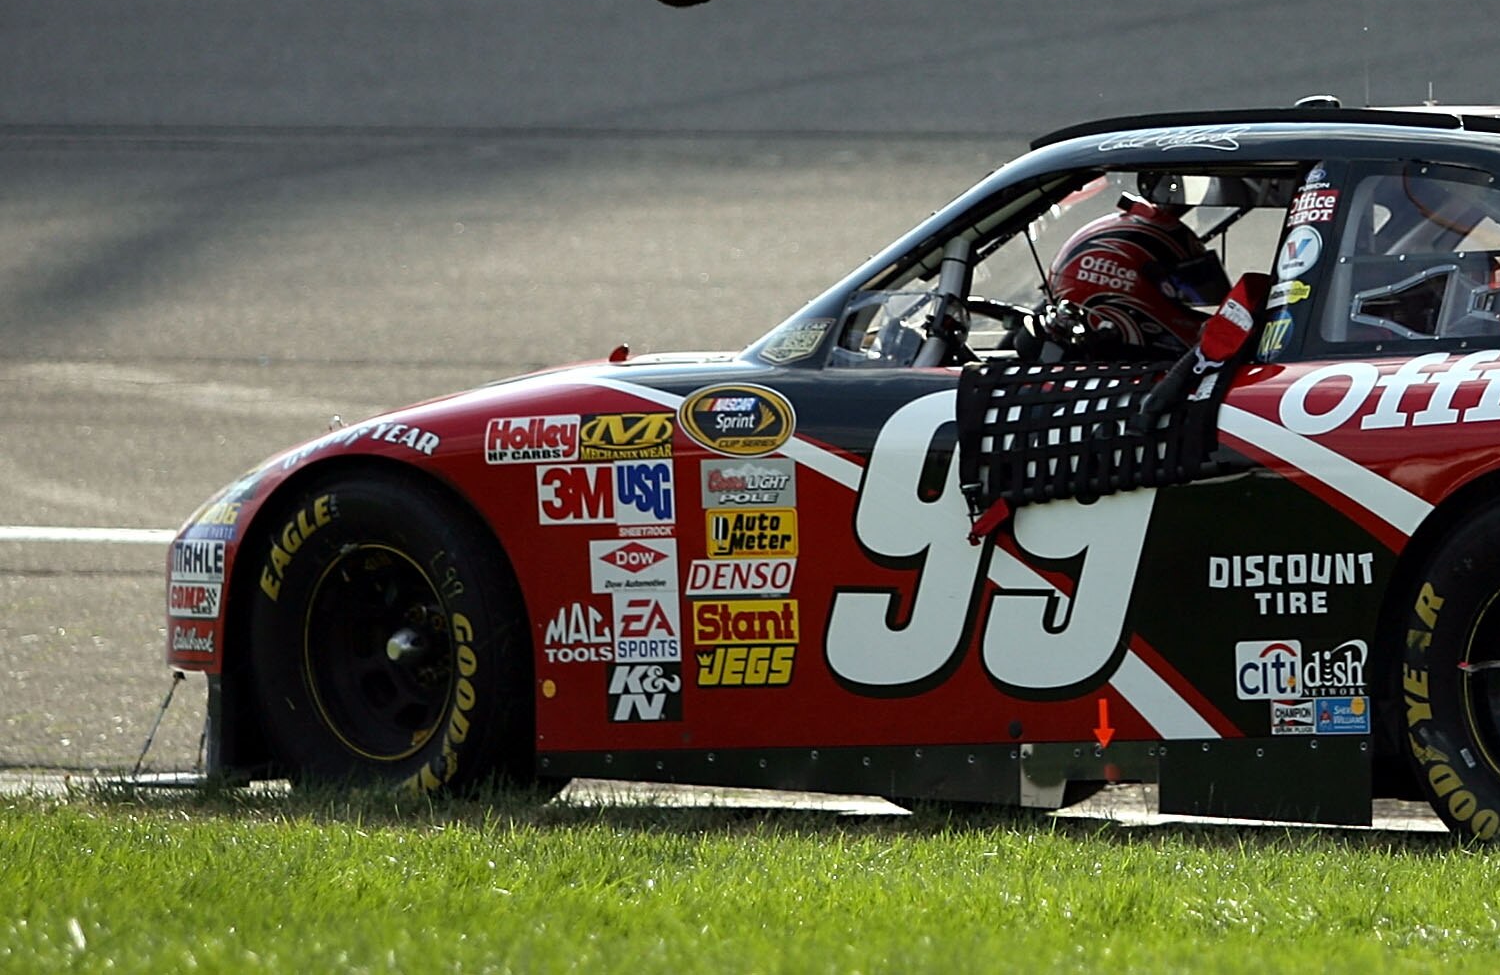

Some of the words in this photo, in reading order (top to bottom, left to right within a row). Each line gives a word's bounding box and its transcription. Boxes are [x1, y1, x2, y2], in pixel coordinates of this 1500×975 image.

[1290, 194, 1337, 214] Office
[1287, 210, 1332, 226] DEPOT
[1080, 256, 1138, 281] Office
[1076, 269, 1135, 293] DEPOT
[715, 413, 756, 433] Sprint
[488, 418, 578, 457] Holley
[719, 439, 740, 448] CUP
[743, 439, 777, 447] SERIES
[488, 451, 507, 461] HP
[511, 449, 562, 461] CARBS
[580, 446, 637, 461] MECHANIX
[639, 444, 673, 458] WEAR
[542, 467, 614, 520] 3M
[617, 463, 672, 520] USG
[746, 475, 790, 491] LIGHT
[718, 493, 779, 505] POLE
[618, 526, 674, 537] SHEETROCK
[732, 513, 780, 532] Auto
[260, 494, 333, 601] EAGLE
[730, 532, 791, 551] Meter
[825, 389, 1158, 690] 99
[174, 543, 223, 574] MAHLE
[1209, 553, 1373, 588] DISCOUNT
[605, 580, 622, 588] Dow
[625, 579, 666, 588] Automotive
[690, 562, 792, 591] DENSO
[1254, 591, 1328, 615] TIRE
[545, 602, 612, 645] MAC
[620, 599, 676, 637] EA
[697, 604, 796, 642] Stant
[545, 647, 613, 663] TOOLS
[618, 640, 678, 657] SPORTS
[698, 647, 796, 685] JEGS
[1239, 648, 1297, 695] citi
[1304, 643, 1367, 687] dish
[1304, 688, 1365, 696] NETWORK
[1275, 708, 1311, 718] CHAMPION
